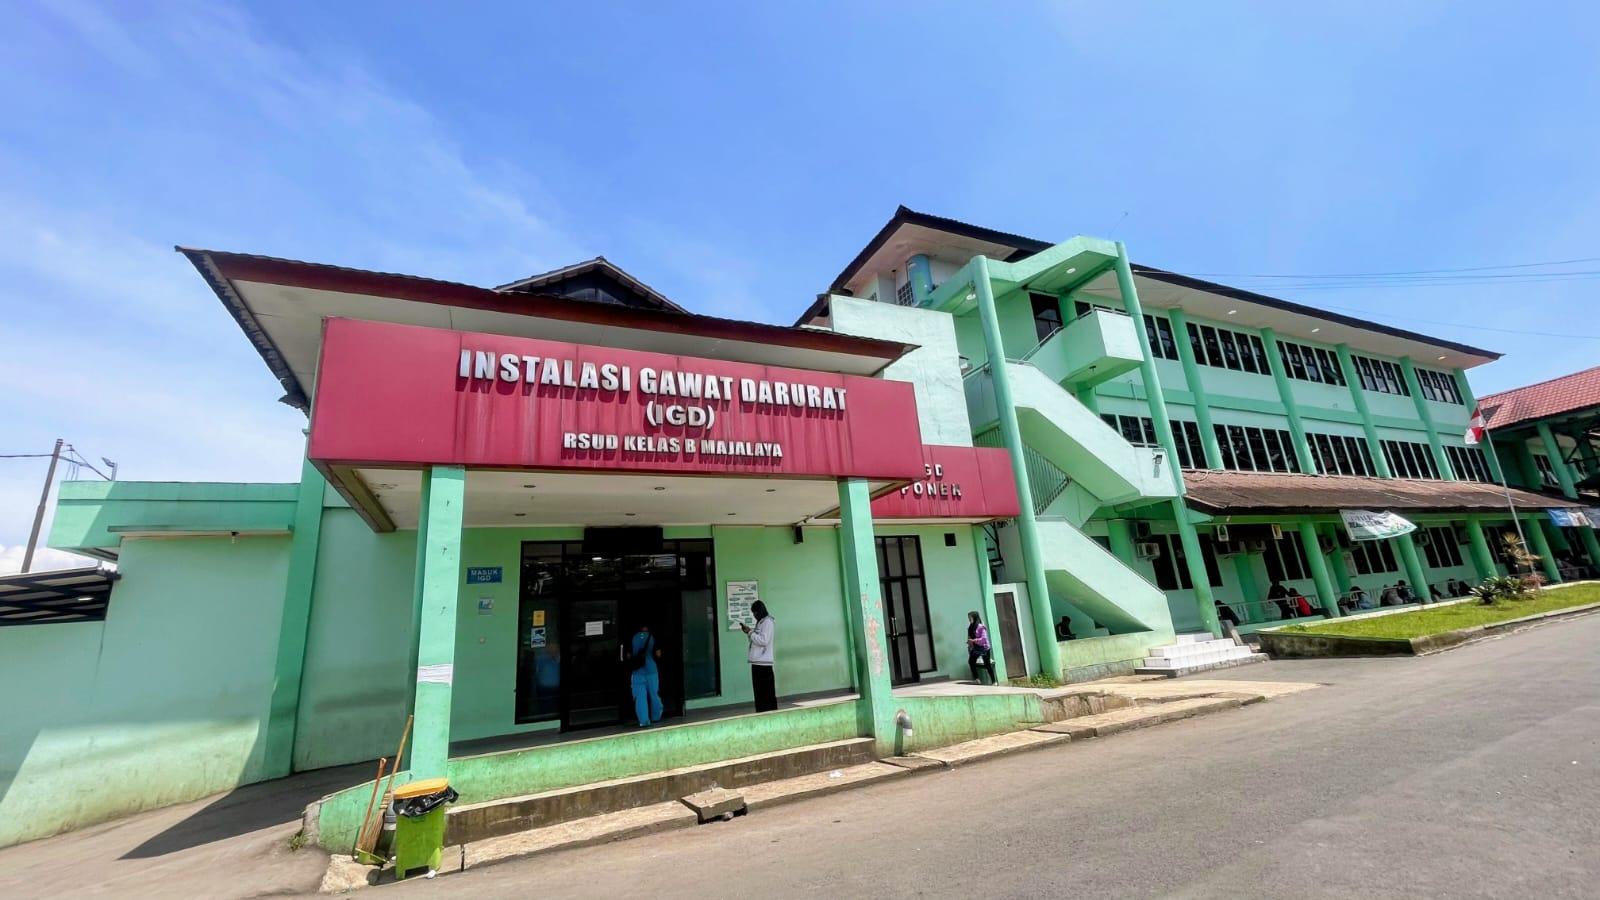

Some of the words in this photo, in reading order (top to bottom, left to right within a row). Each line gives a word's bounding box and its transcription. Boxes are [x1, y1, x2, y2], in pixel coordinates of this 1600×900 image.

[459, 349, 632, 392] INSTALASI
[639, 367, 734, 401] GAWAT
[740, 377, 847, 411] DARURAT
[646, 400, 715, 430] (IGD)
[563, 432, 619, 450] RSUD
[624, 435, 681, 453] KELAS
[685, 438, 696, 453] B
[701, 439, 783, 458] MAJALAYA
